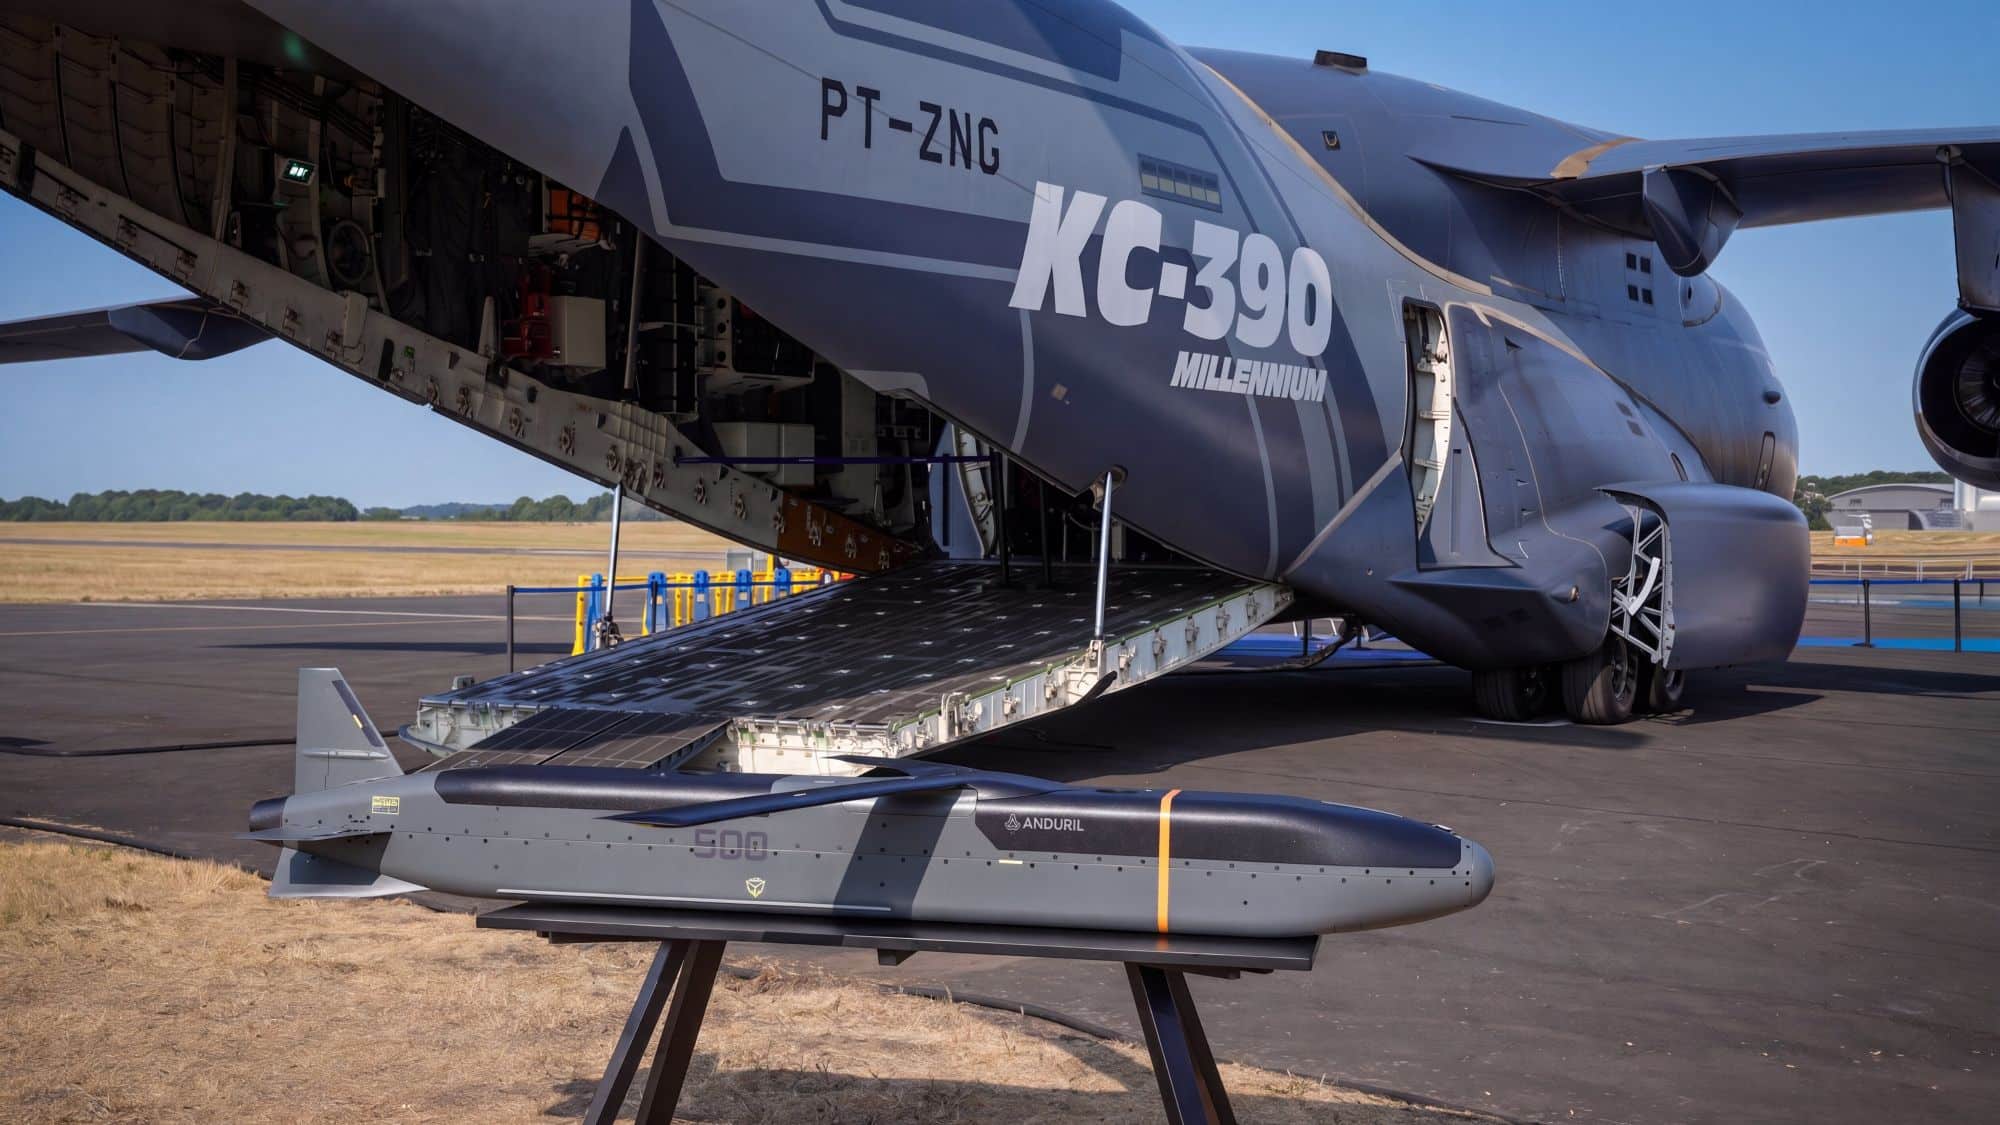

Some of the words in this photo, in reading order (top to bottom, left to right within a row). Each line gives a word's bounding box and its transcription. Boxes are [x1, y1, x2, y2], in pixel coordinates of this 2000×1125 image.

[821, 77, 1000, 175] PT-ZNG
[1008, 181, 1332, 357] KC-390
[1170, 351, 1328, 402] MILLENNIUM
[695, 829, 768, 861] 500
[1022, 816, 1085, 832] ANDURIL
